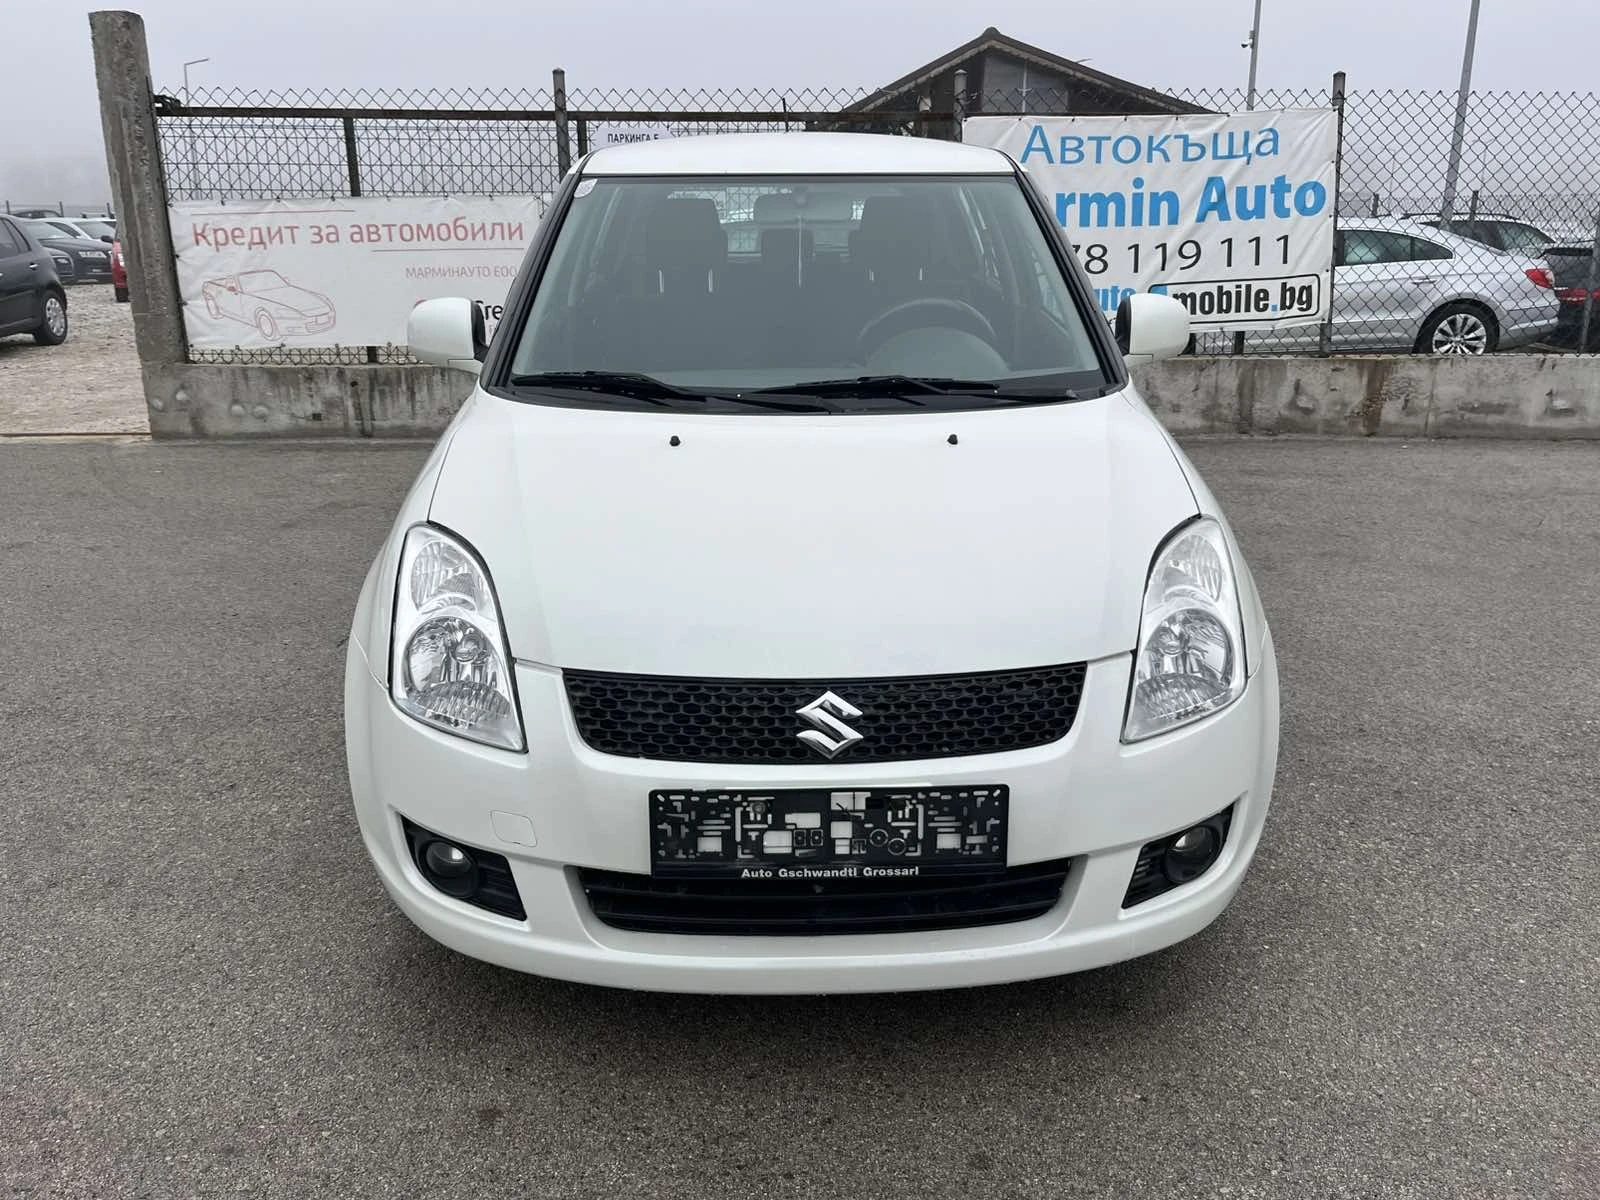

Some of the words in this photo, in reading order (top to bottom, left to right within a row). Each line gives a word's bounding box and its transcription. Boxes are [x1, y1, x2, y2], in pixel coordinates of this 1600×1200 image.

[608, 133, 651, 143] ПАРКИНГА
[1020, 125, 1280, 164] Автокъща
[1195, 175, 1327, 224] Auto
[192, 223, 299, 251] Кредит
[310, 224, 340, 245] за
[349, 216, 524, 244] автомобили
[1127, 240, 1202, 274] 119
[1220, 234, 1290, 269] 111
[405, 265, 491, 279] МАРМИНАУТО
[741, 868, 773, 878] Auto
